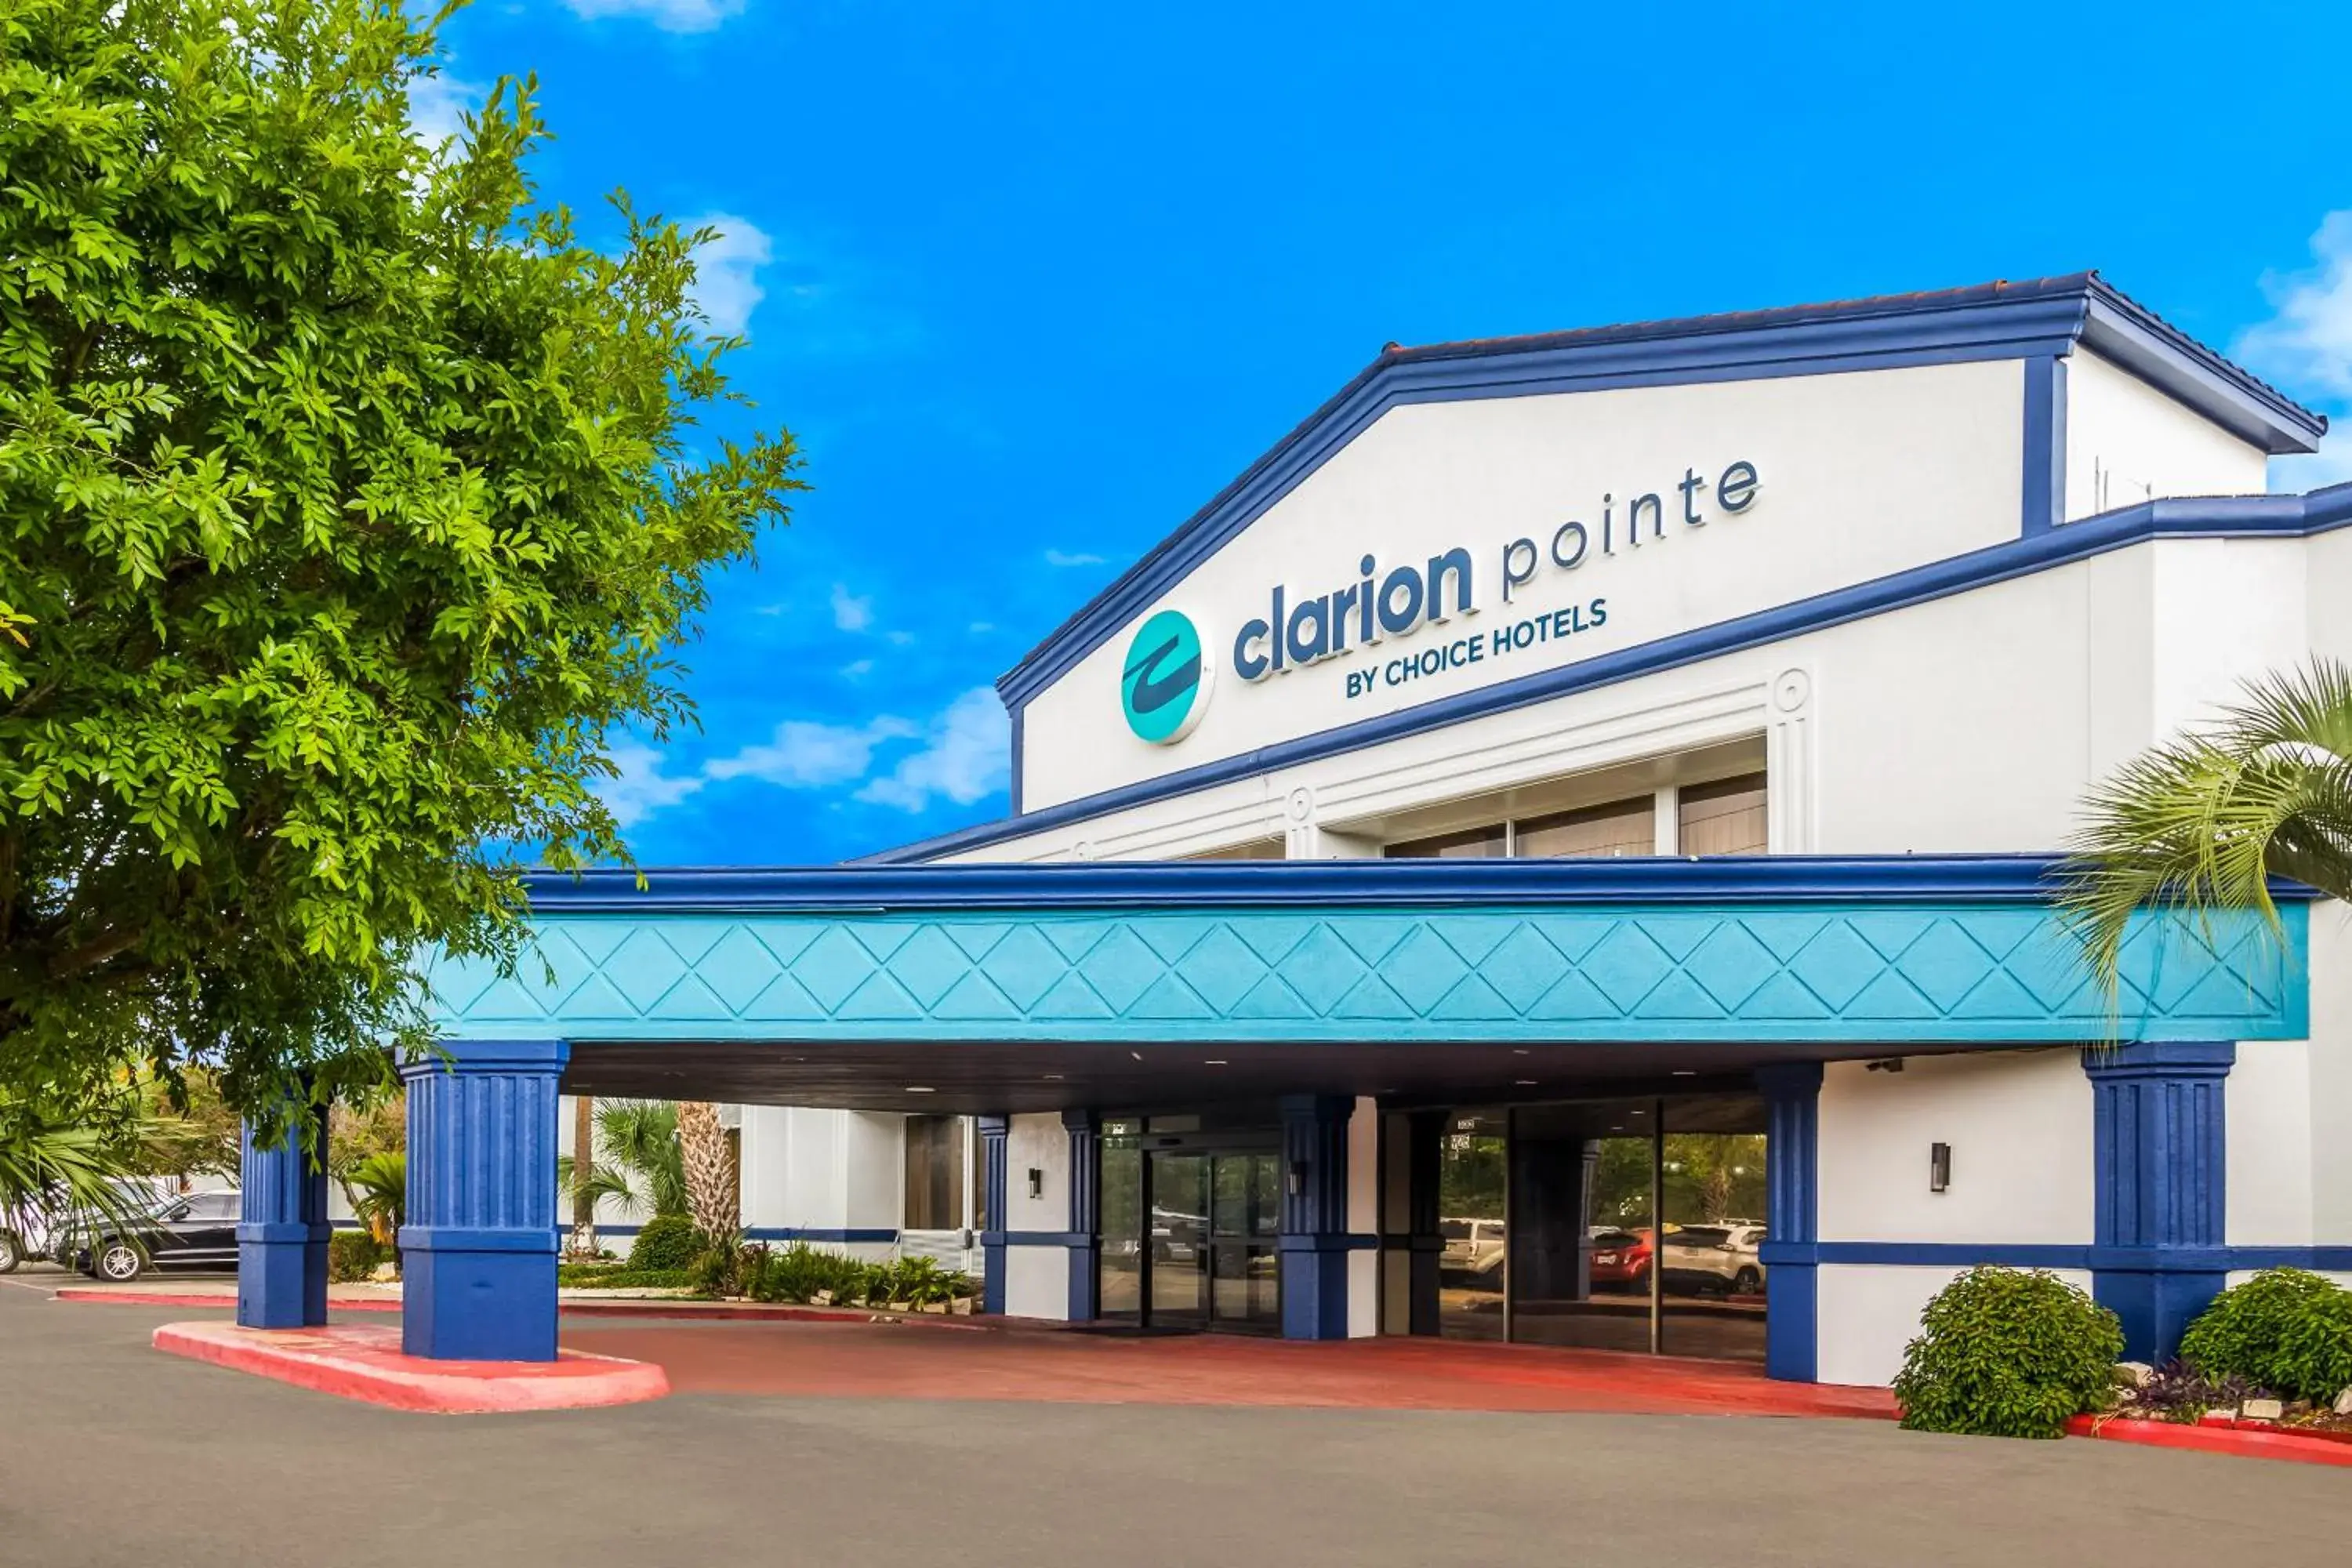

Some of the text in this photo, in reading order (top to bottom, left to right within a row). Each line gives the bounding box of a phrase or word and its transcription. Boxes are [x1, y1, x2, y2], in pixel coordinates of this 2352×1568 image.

[1233, 461, 1759, 681] clarion pointe
[1346, 598, 1607, 699] BY CHOICE HOTELS
